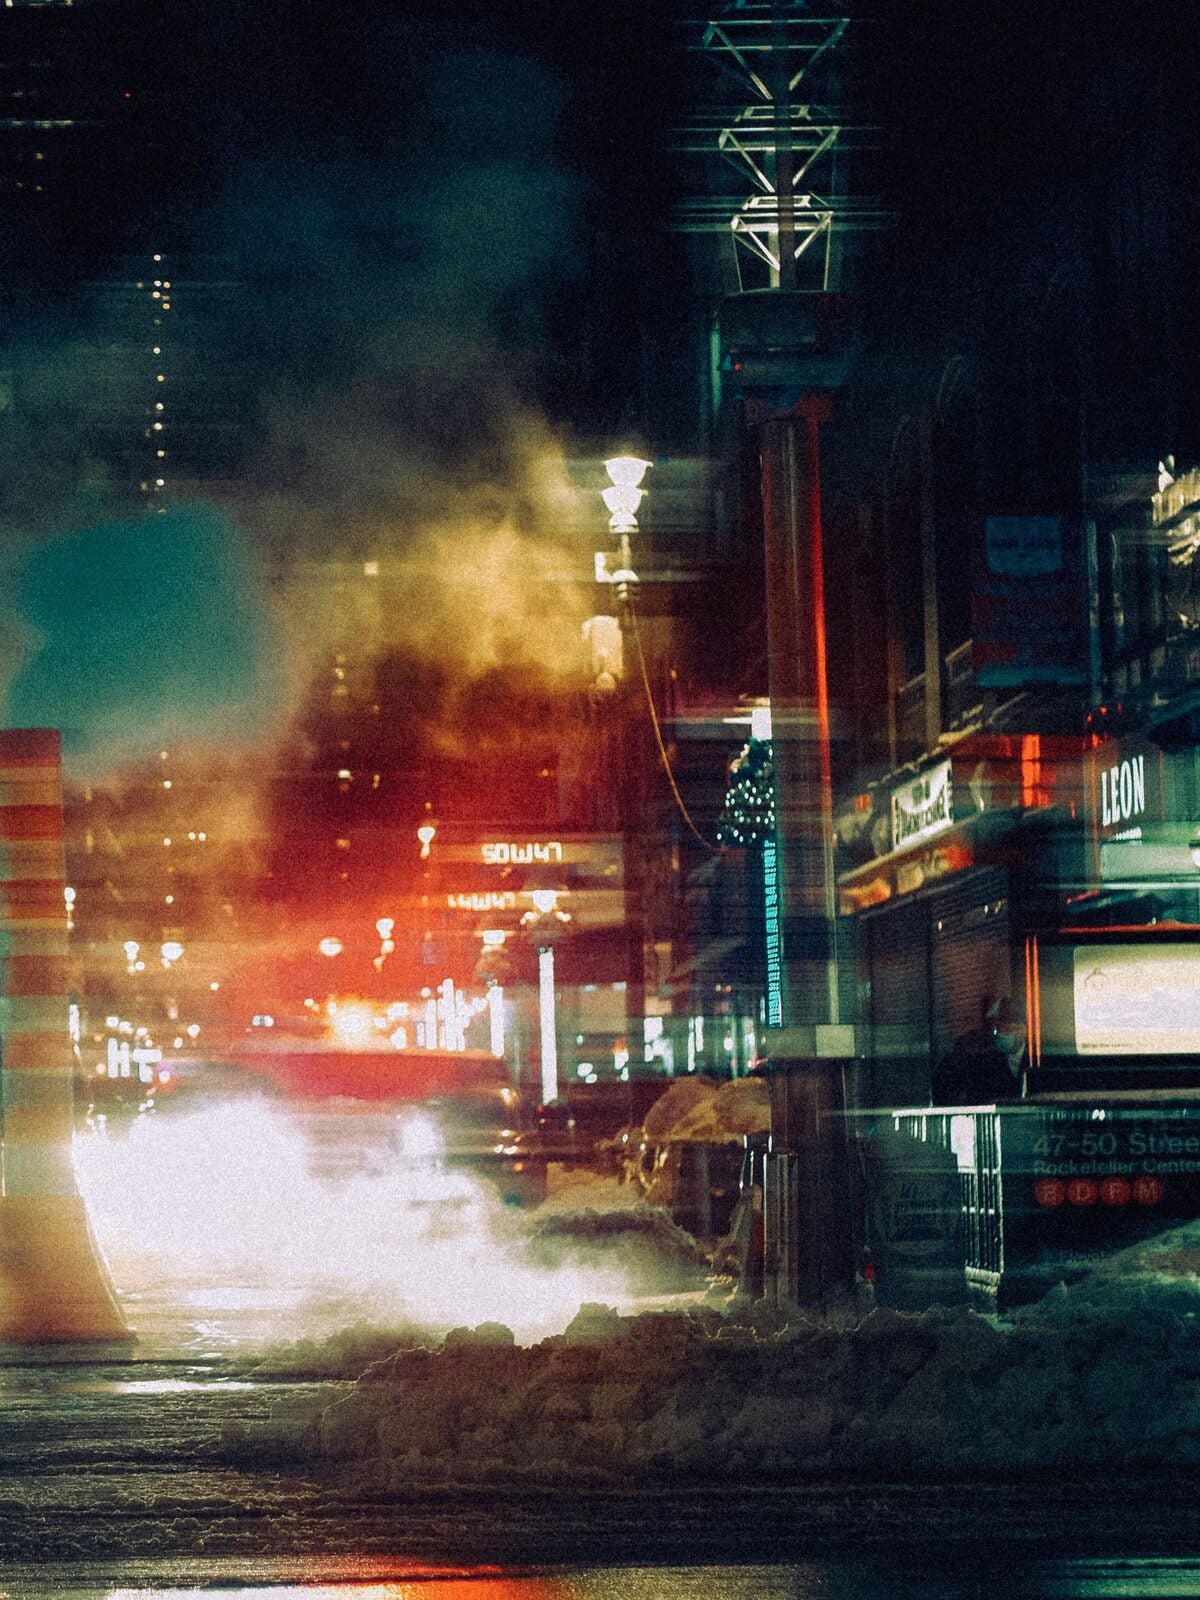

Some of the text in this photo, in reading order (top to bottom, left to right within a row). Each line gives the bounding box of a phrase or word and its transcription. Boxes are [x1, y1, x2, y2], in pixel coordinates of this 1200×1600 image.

[1101, 754, 1145, 827] LEON
[1033, 1133, 1118, 1156] 47-50
[1034, 1159, 1134, 1175] Rockefeller
